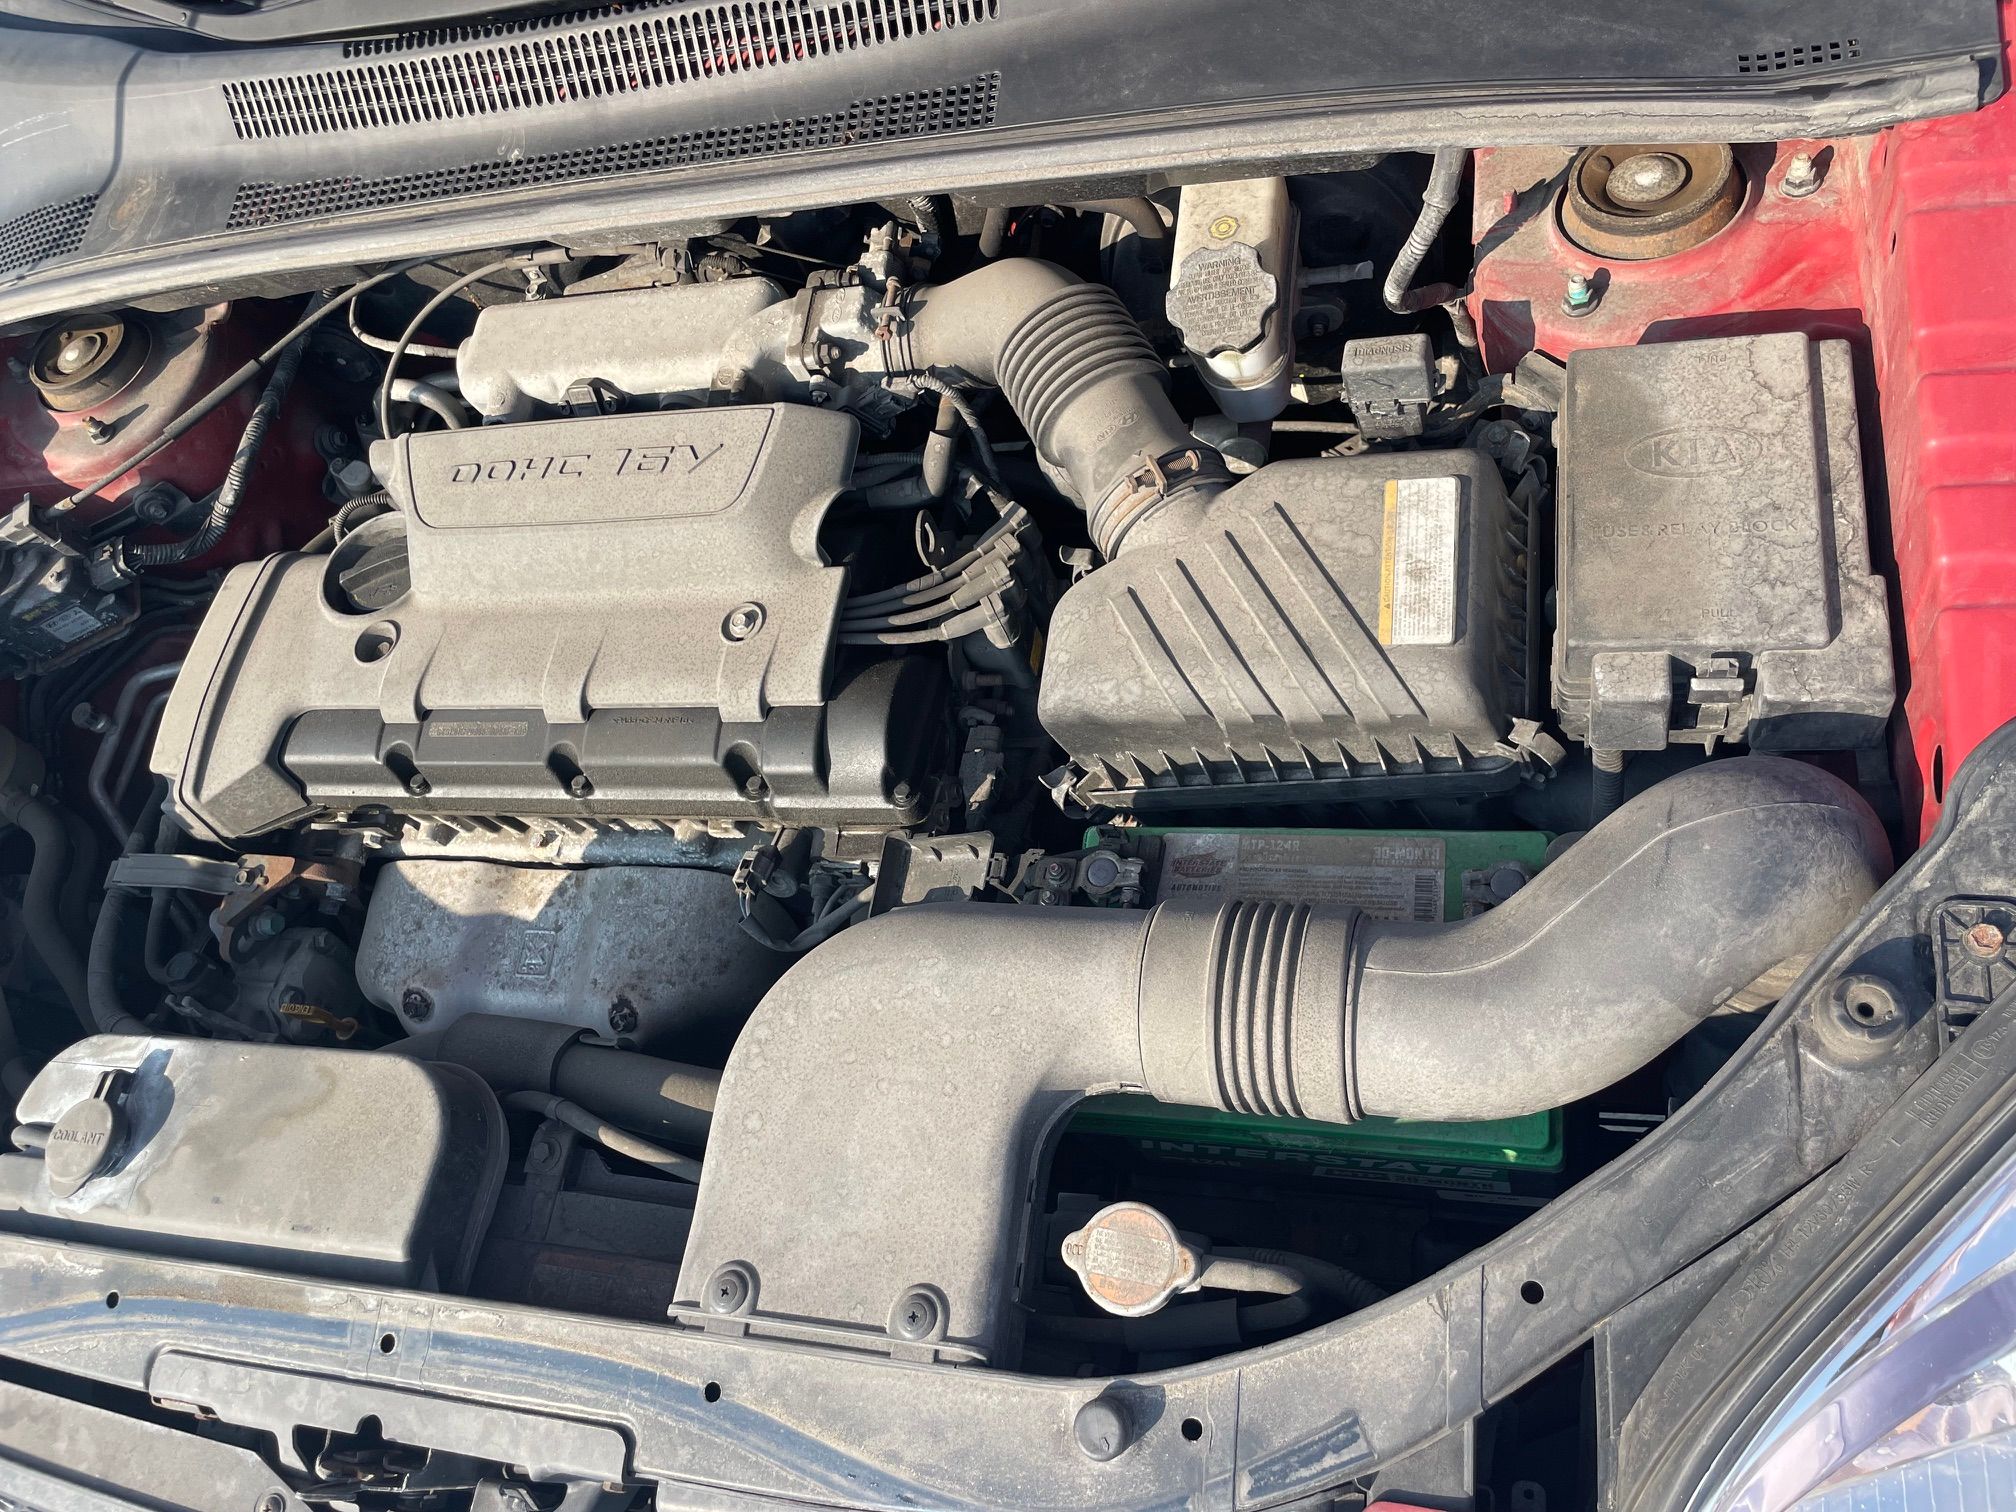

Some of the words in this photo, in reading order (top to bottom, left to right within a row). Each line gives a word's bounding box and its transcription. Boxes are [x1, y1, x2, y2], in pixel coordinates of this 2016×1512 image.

[1198, 256, 1241, 271] WARNING
[451, 454, 592, 484] DOHC
[615, 442, 725, 476] 16V
[1651, 436, 1745, 468] KIA
[1729, 517, 1799, 534] BLOCK
[53, 1129, 105, 1145] COOLANT
[1141, 1139, 1498, 1178] INTERSTATE
